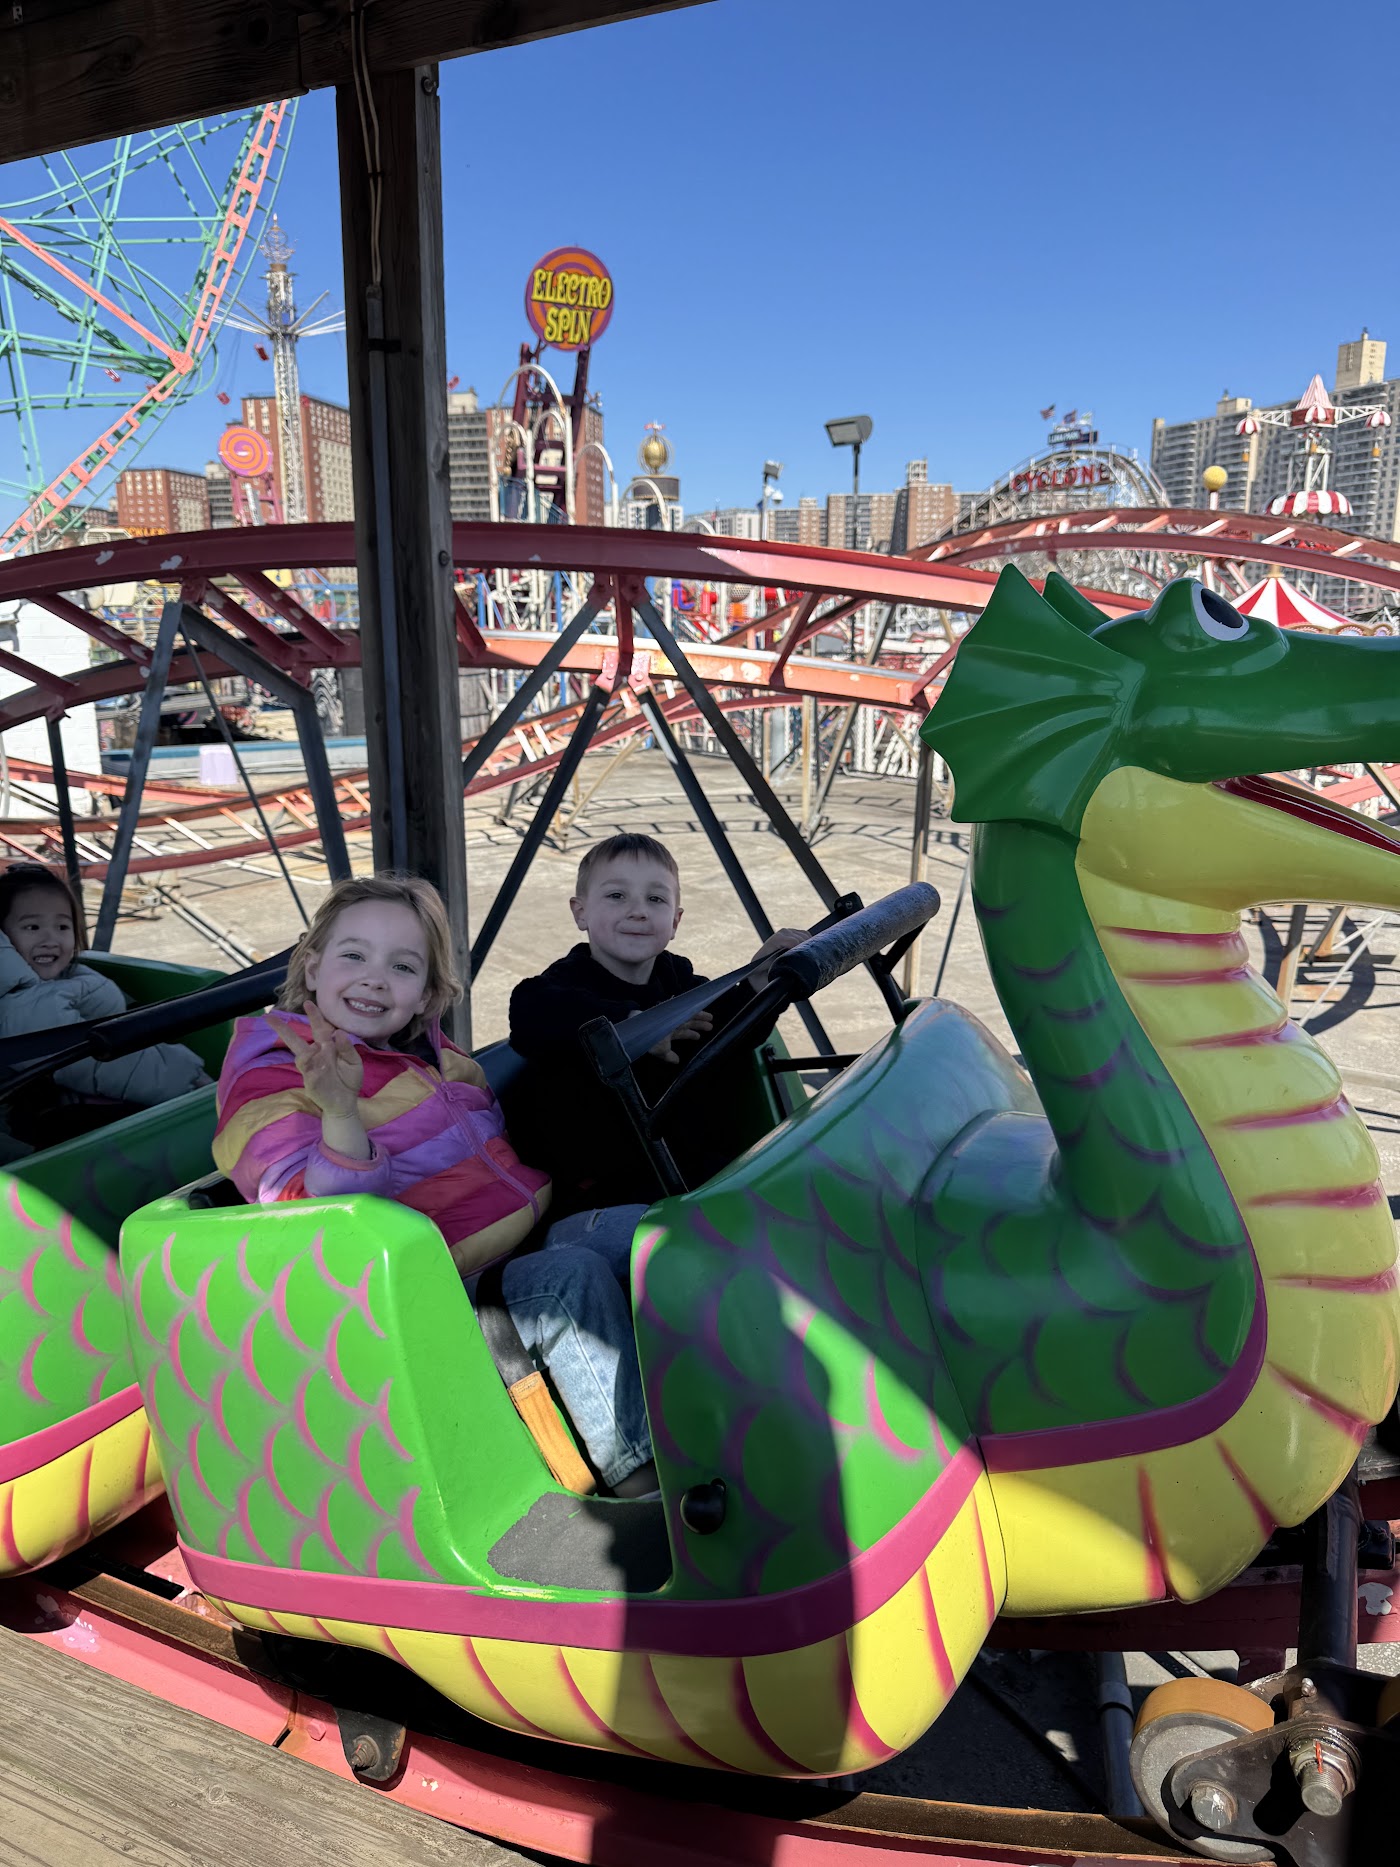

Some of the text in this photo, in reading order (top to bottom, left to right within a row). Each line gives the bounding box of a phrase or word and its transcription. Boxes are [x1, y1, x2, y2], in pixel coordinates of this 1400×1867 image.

[531, 268, 612, 309] ELECTRO
[544, 306, 593, 345] SPIN
[1012, 464, 1110, 492] CYCLONE
